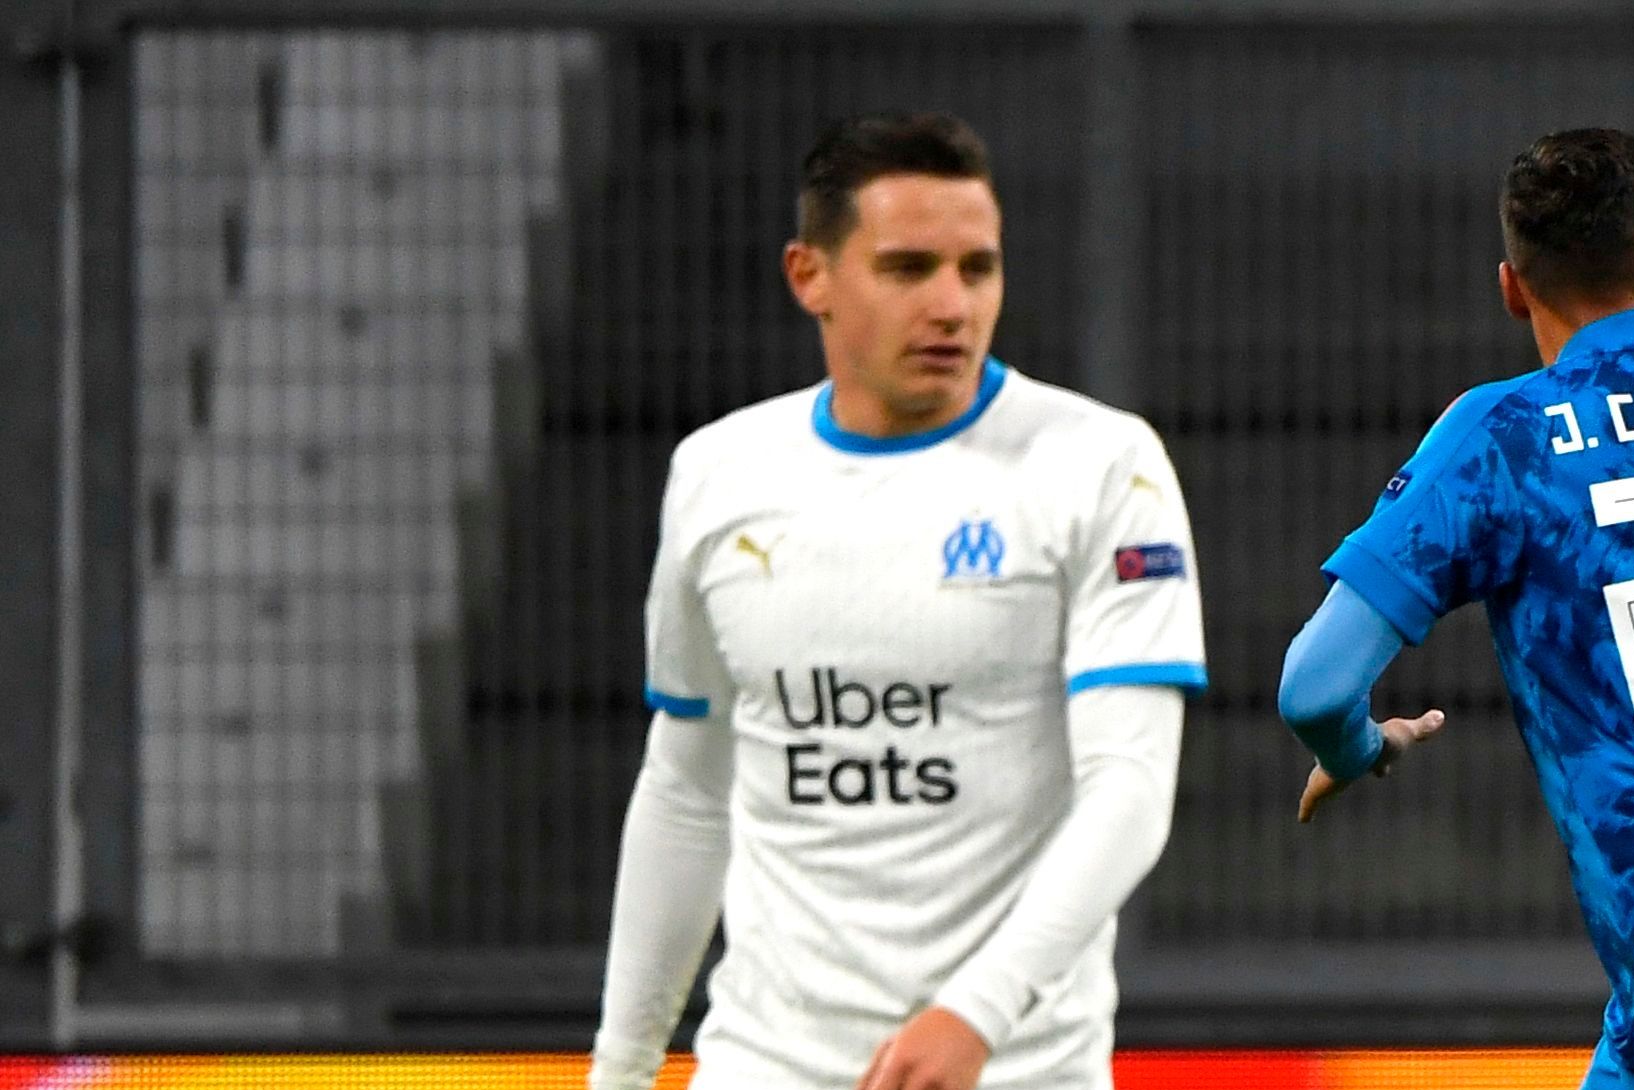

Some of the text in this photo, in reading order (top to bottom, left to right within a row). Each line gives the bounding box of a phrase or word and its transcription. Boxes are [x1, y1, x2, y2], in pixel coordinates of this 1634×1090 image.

[1543, 401, 1599, 455] J.
[775, 666, 953, 730] Uber
[784, 742, 959, 806] Eats
